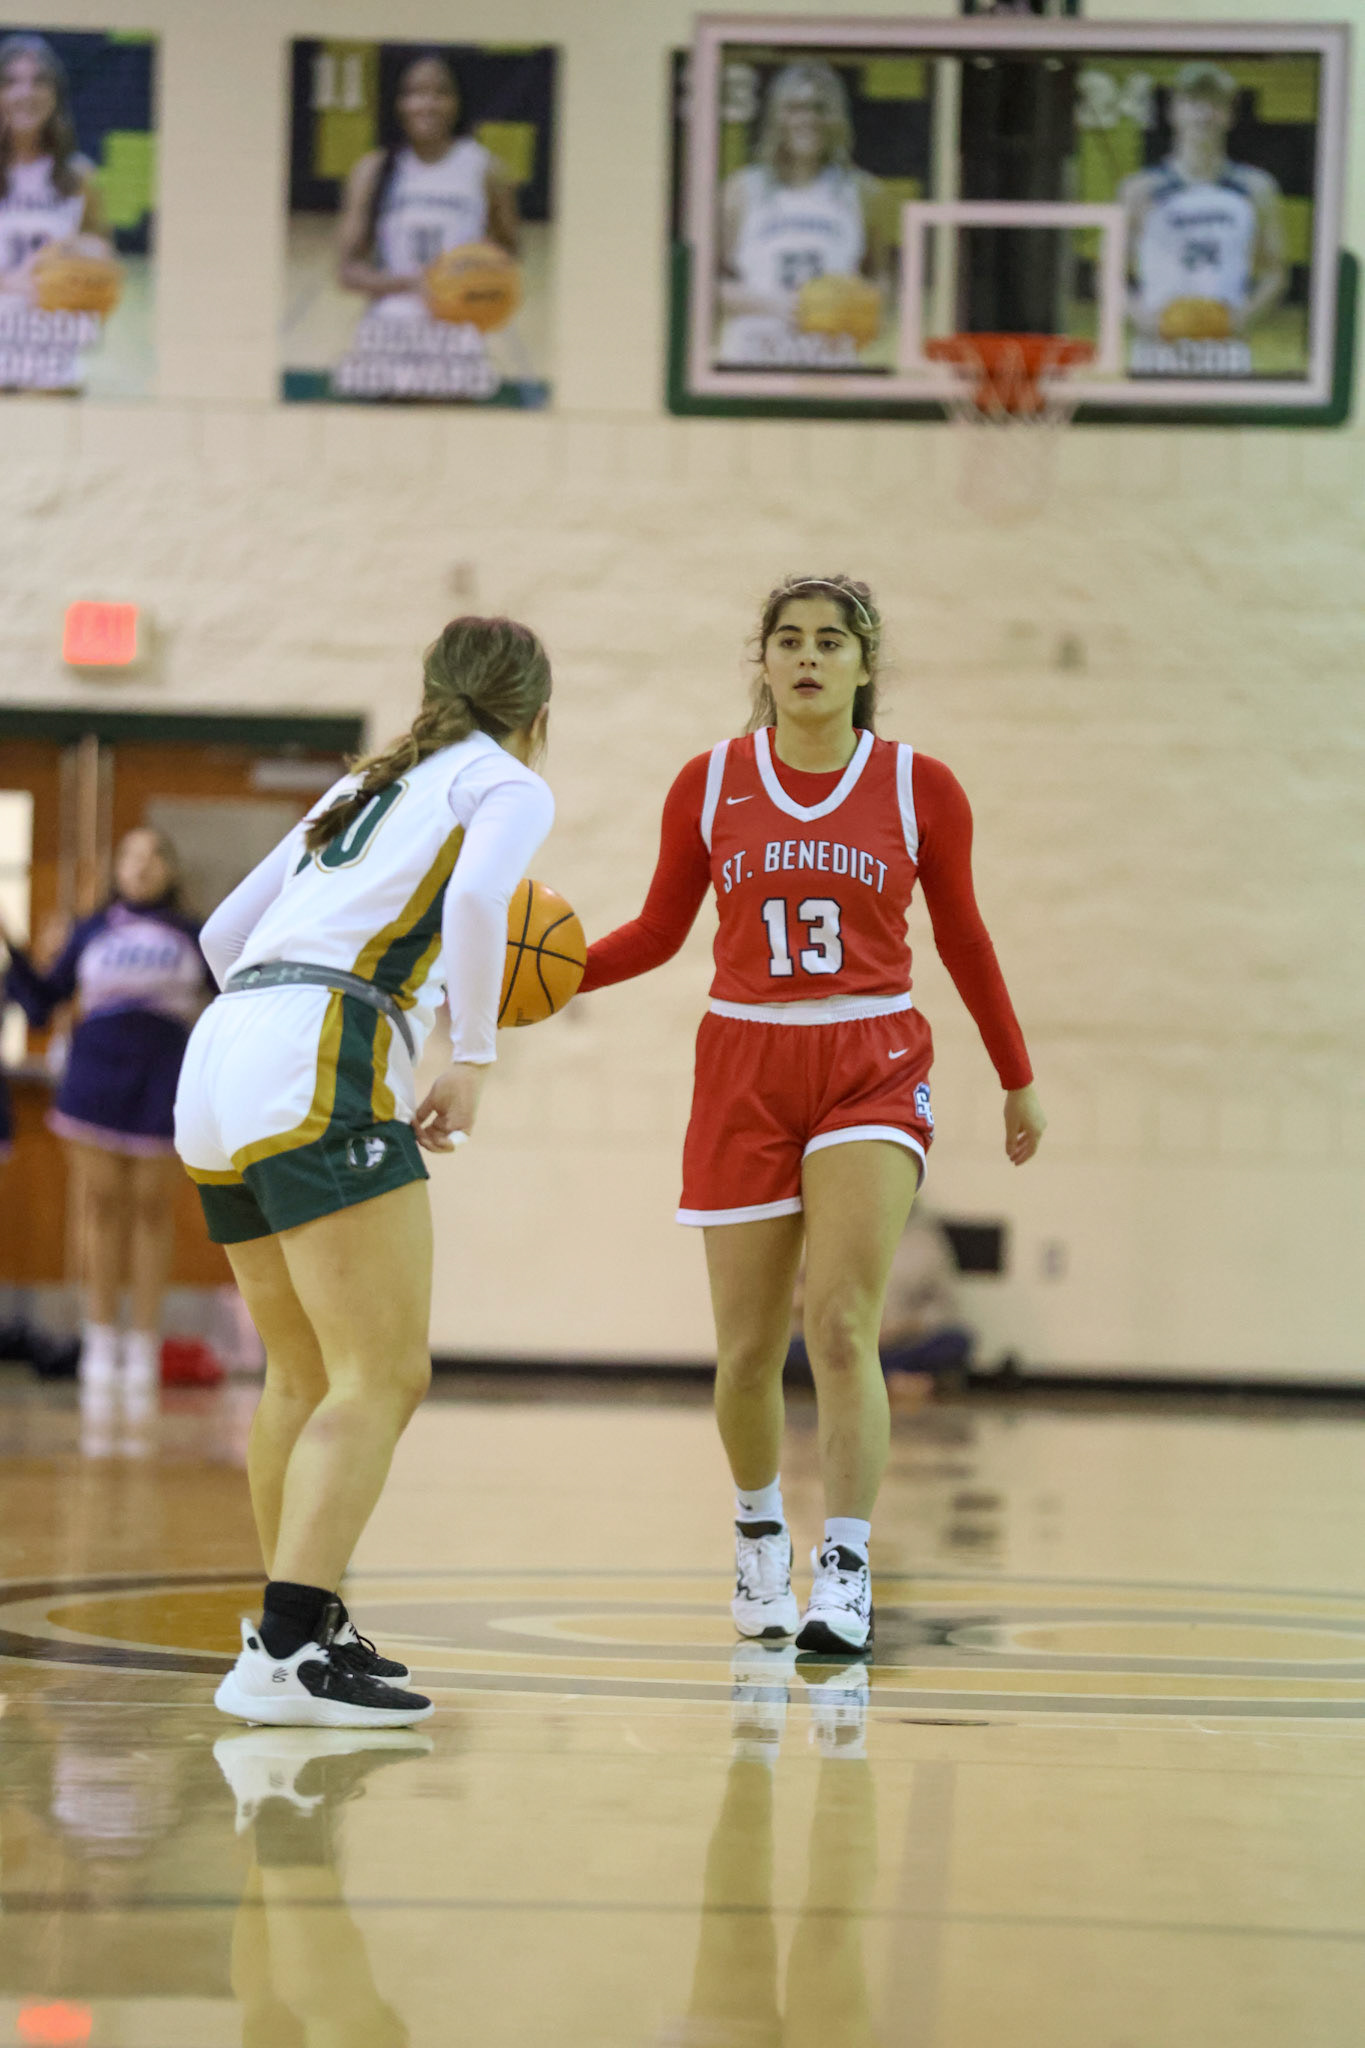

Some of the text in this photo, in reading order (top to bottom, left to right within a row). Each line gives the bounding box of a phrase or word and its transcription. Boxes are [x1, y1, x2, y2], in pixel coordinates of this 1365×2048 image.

[722, 840, 889, 894] ST. BENEDICT
[761, 898, 844, 977] 13
